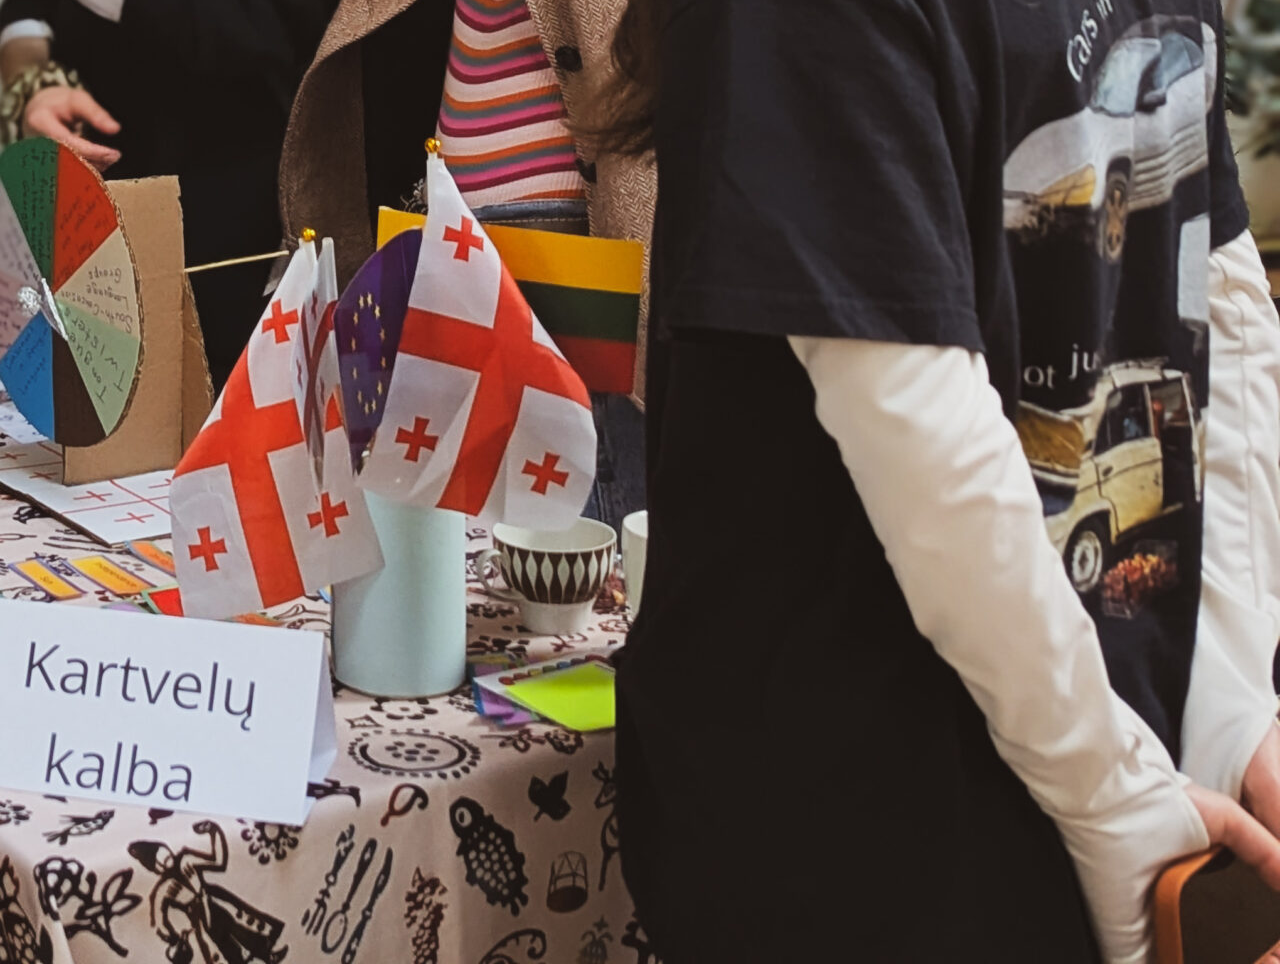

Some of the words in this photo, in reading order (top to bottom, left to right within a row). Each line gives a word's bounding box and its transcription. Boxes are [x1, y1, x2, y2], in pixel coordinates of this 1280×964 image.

[1066, 9, 1098, 83] Cars
[86, 281, 130, 311] Language
[64, 307, 126, 393] Twisters
[67, 332, 107, 404] Tongue
[1023, 364, 1056, 389] ot
[24, 640, 256, 732] Kartvelų
[45, 732, 193, 803] kalba
